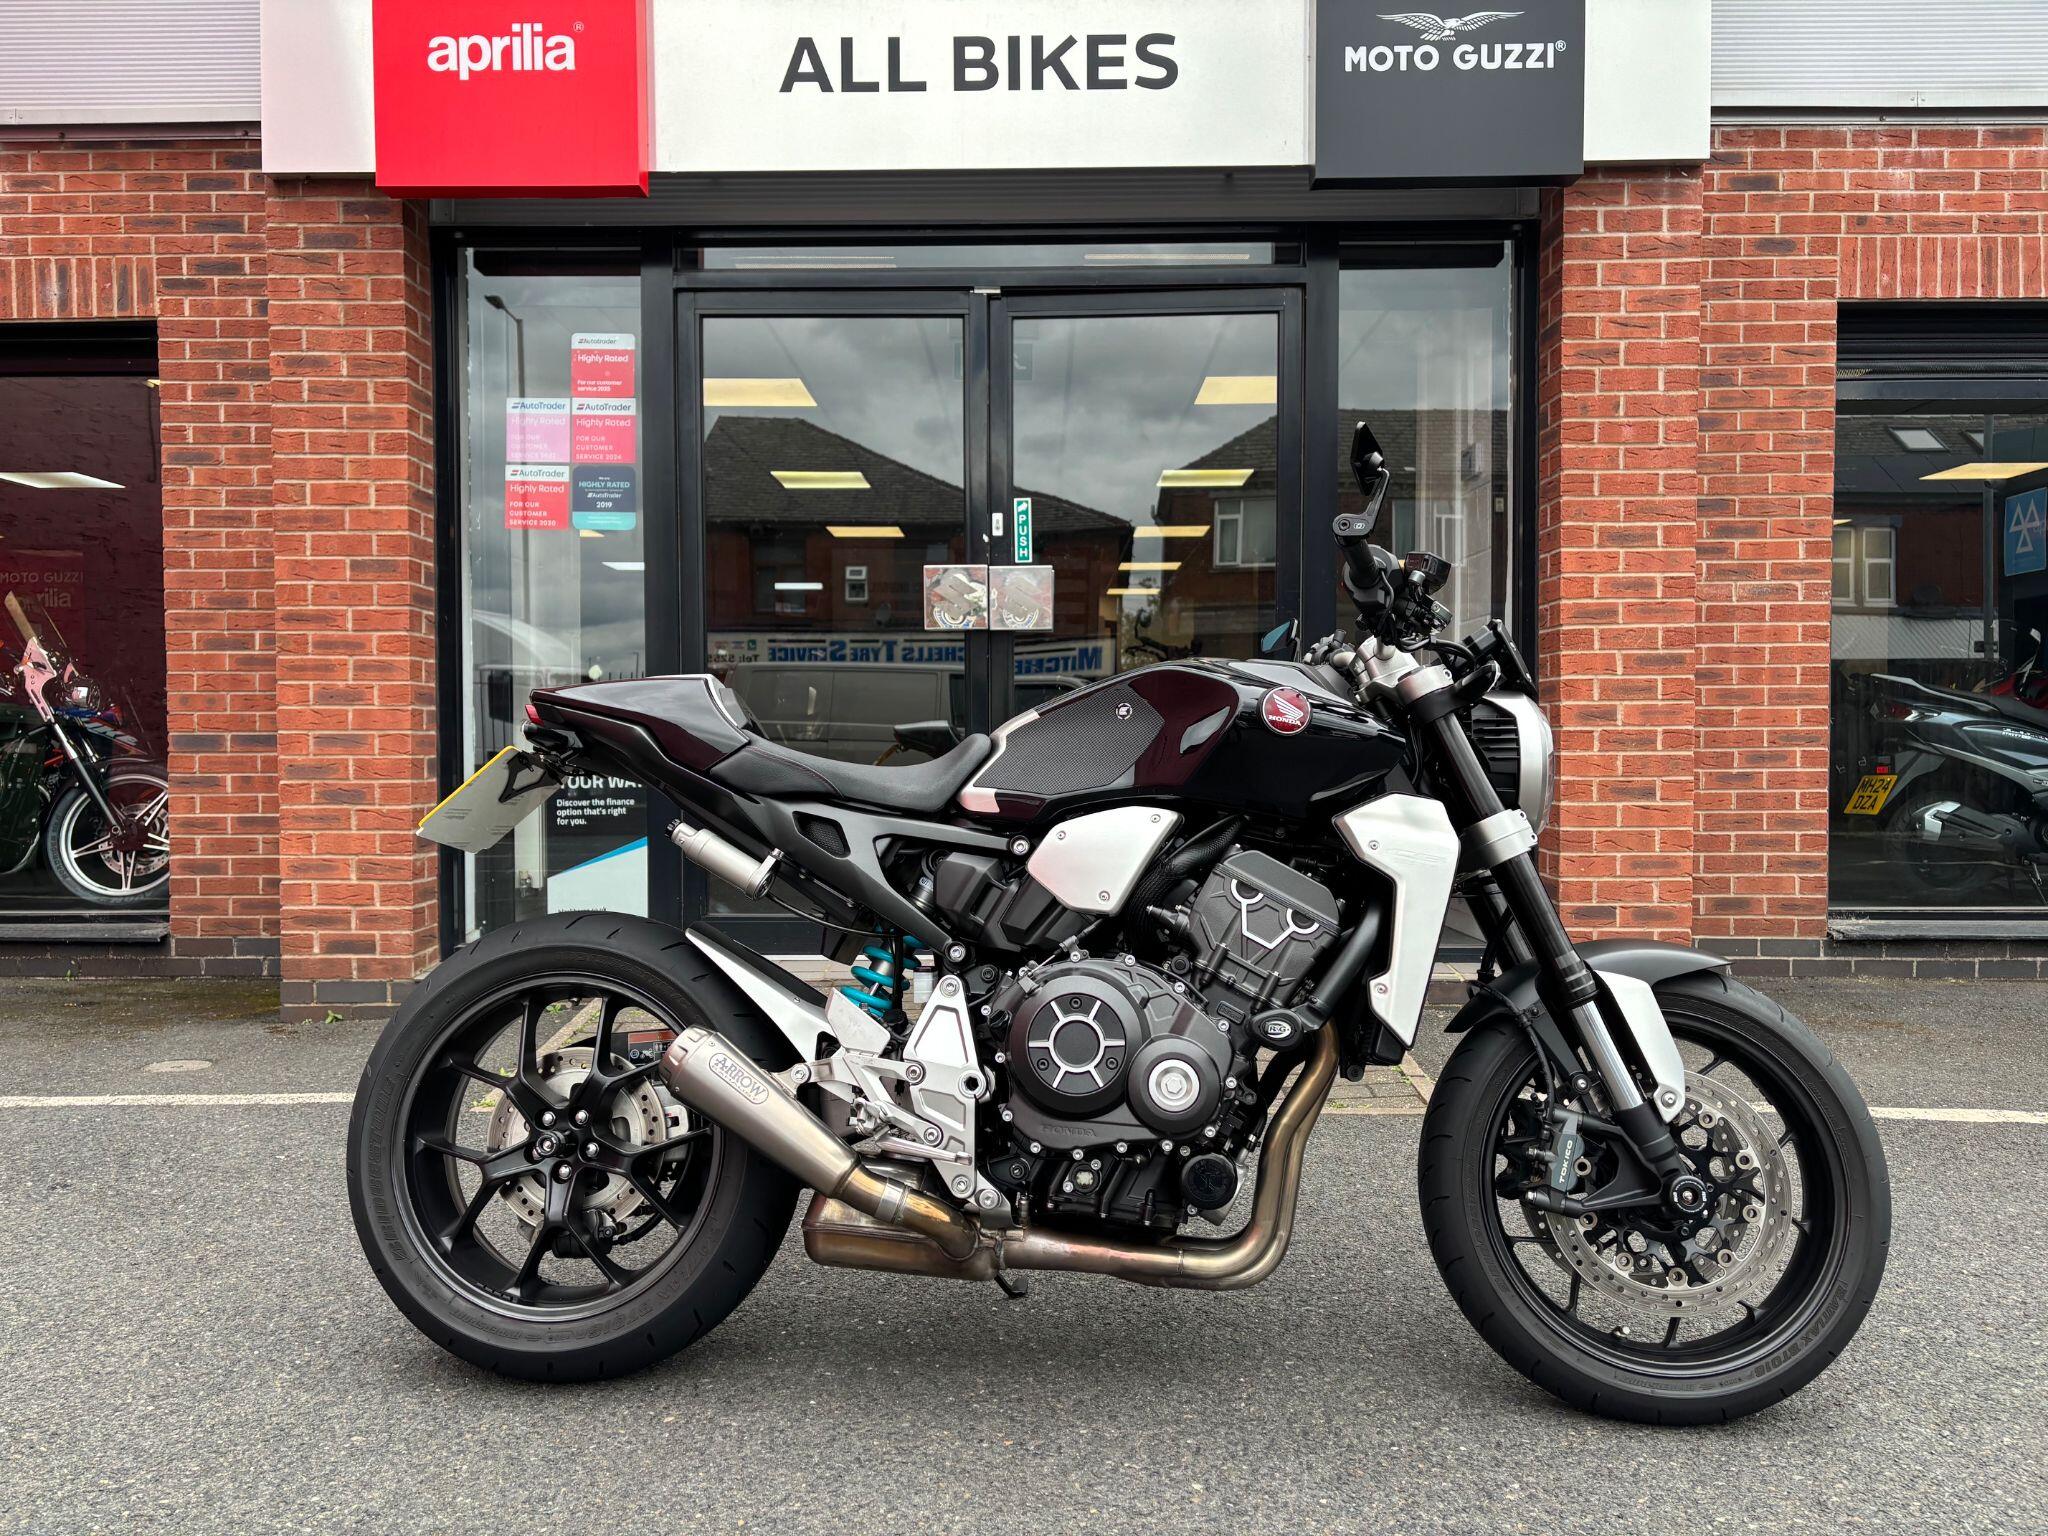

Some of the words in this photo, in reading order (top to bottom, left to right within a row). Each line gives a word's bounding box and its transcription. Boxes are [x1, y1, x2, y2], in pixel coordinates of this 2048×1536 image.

[779, 37, 928, 93] ALL
[953, 33, 1179, 92] BIKES
[1344, 44, 1440, 72] MOTO
[577, 353, 603, 364] Highly
[604, 354, 629, 363] Rated
[519, 402, 566, 410] AutoTrader
[585, 403, 632, 411] AutoTrader
[576, 418, 603, 428] Highly
[604, 418, 631, 427] Rated
[519, 469, 565, 478] AutoTrader
[510, 484, 537, 494] Highly
[538, 484, 565, 494] Rated
[1018, 515, 1028, 557] PUSH
[0, 571, 39, 583] MOTO
[43, 571, 84, 583] GUZZI
[1268, 714, 1302, 727] HONDA
[1857, 778, 1892, 794] MH24
[556, 799, 590, 807] Discover
[606, 798, 635, 806] finance
[1853, 795, 1879, 810] DZA
[556, 808, 582, 817] option
[584, 807, 606, 816] that's
[608, 807, 627, 817] right
[557, 817, 569, 826] for
[570, 818, 587, 826] you.
[715, 1056, 766, 1098] ARROW
[1558, 1139, 1575, 1185] TOKICO
